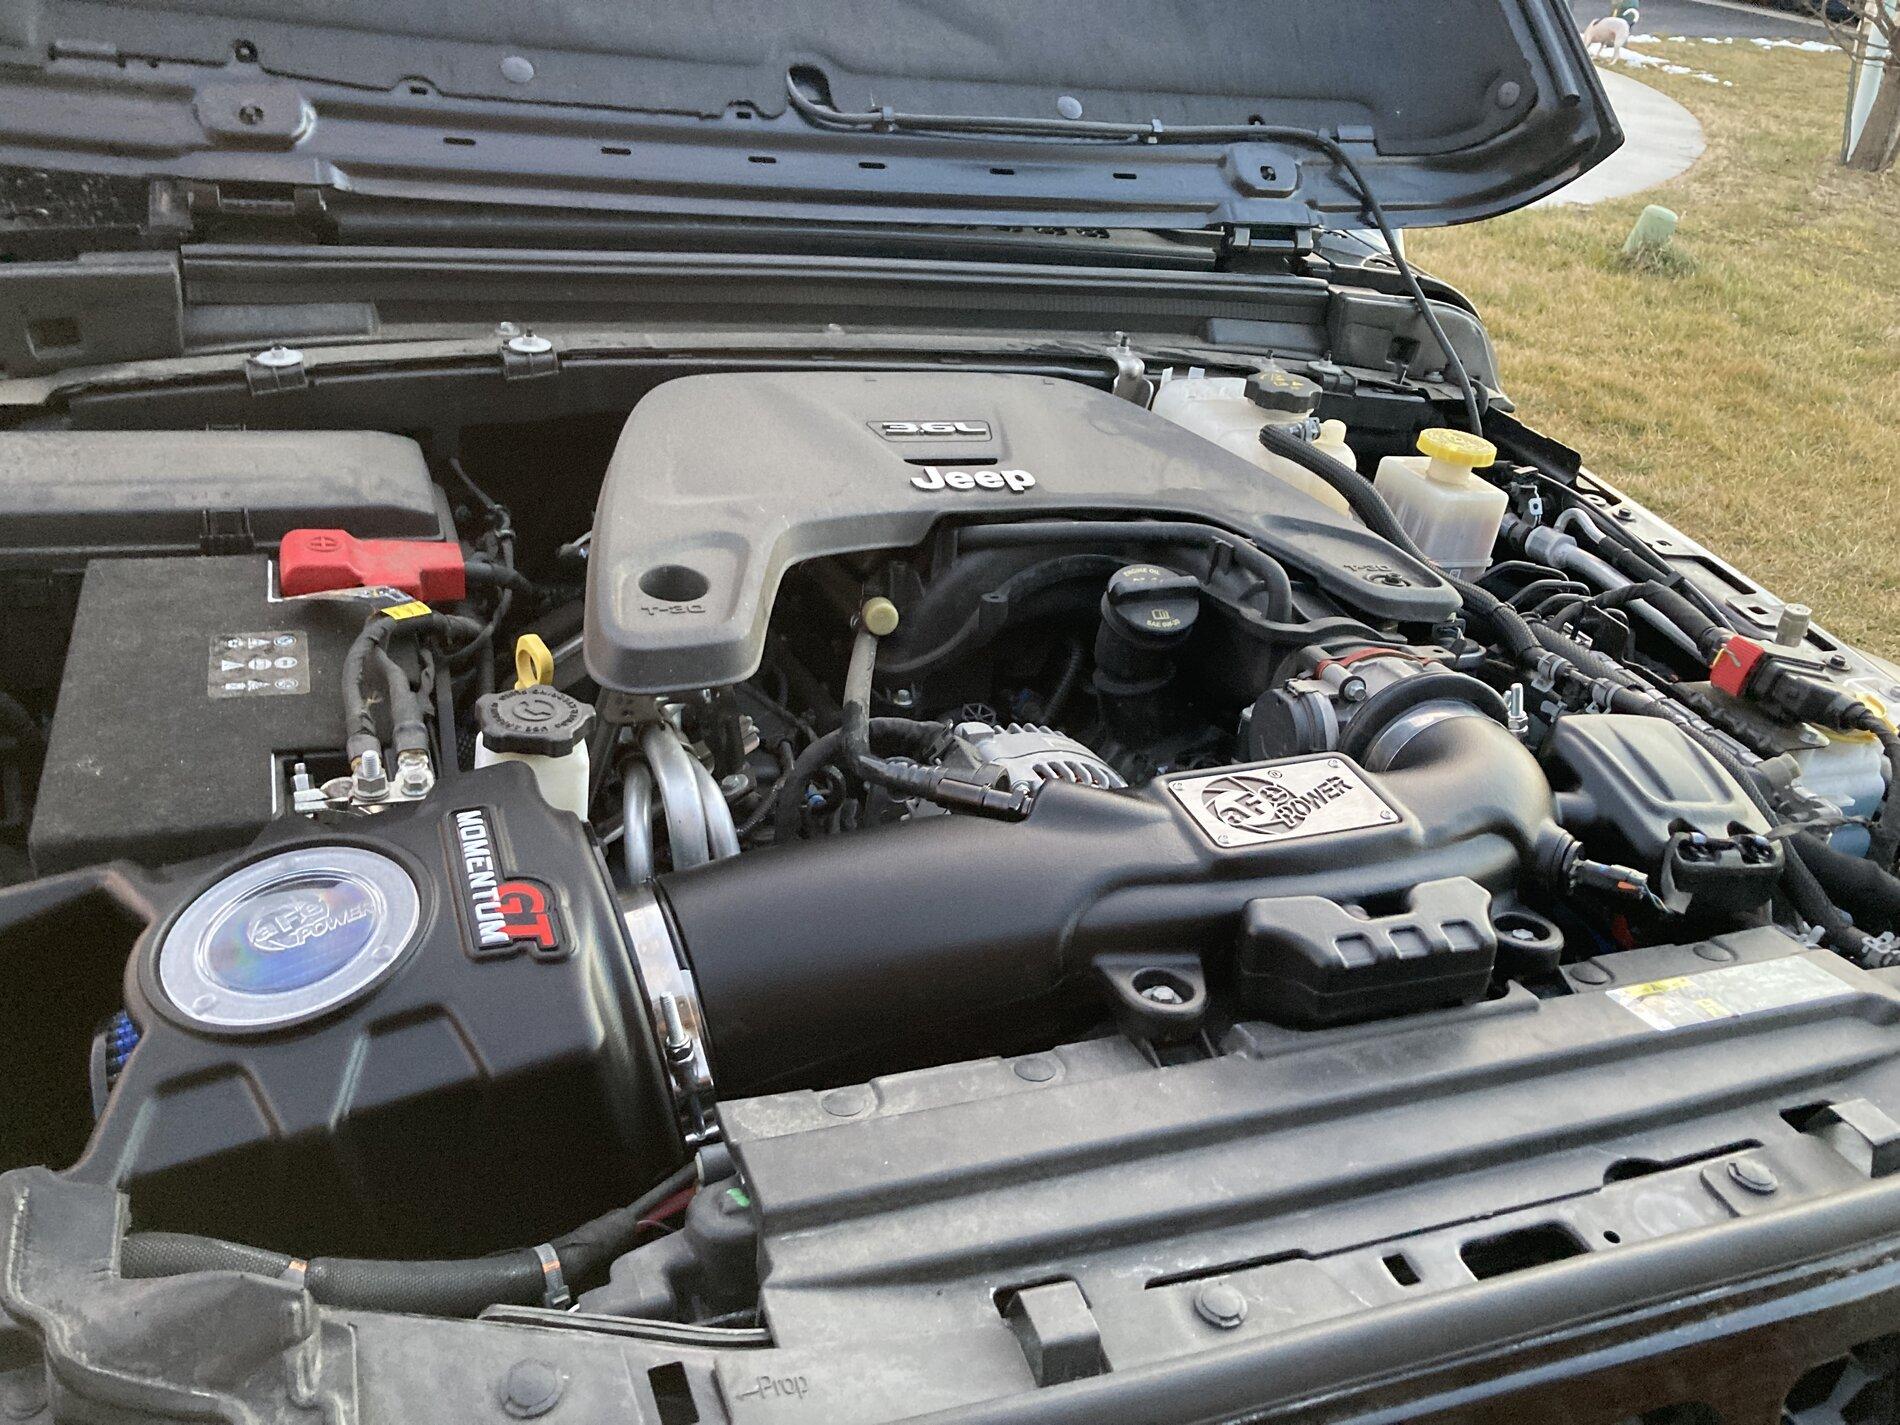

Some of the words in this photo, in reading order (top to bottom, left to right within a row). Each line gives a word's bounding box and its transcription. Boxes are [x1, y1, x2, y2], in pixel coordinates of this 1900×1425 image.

[882, 422, 987, 435] 3.6L
[910, 466, 1036, 494] Jeep
[1149, 568, 1161, 576] OIL
[1274, 775, 1354, 827] POWER
[456, 810, 510, 944] MOMENTUM
[497, 882, 555, 946] GT
[297, 903, 374, 945] POWER
[757, 1375, 808, 1400] Prop
